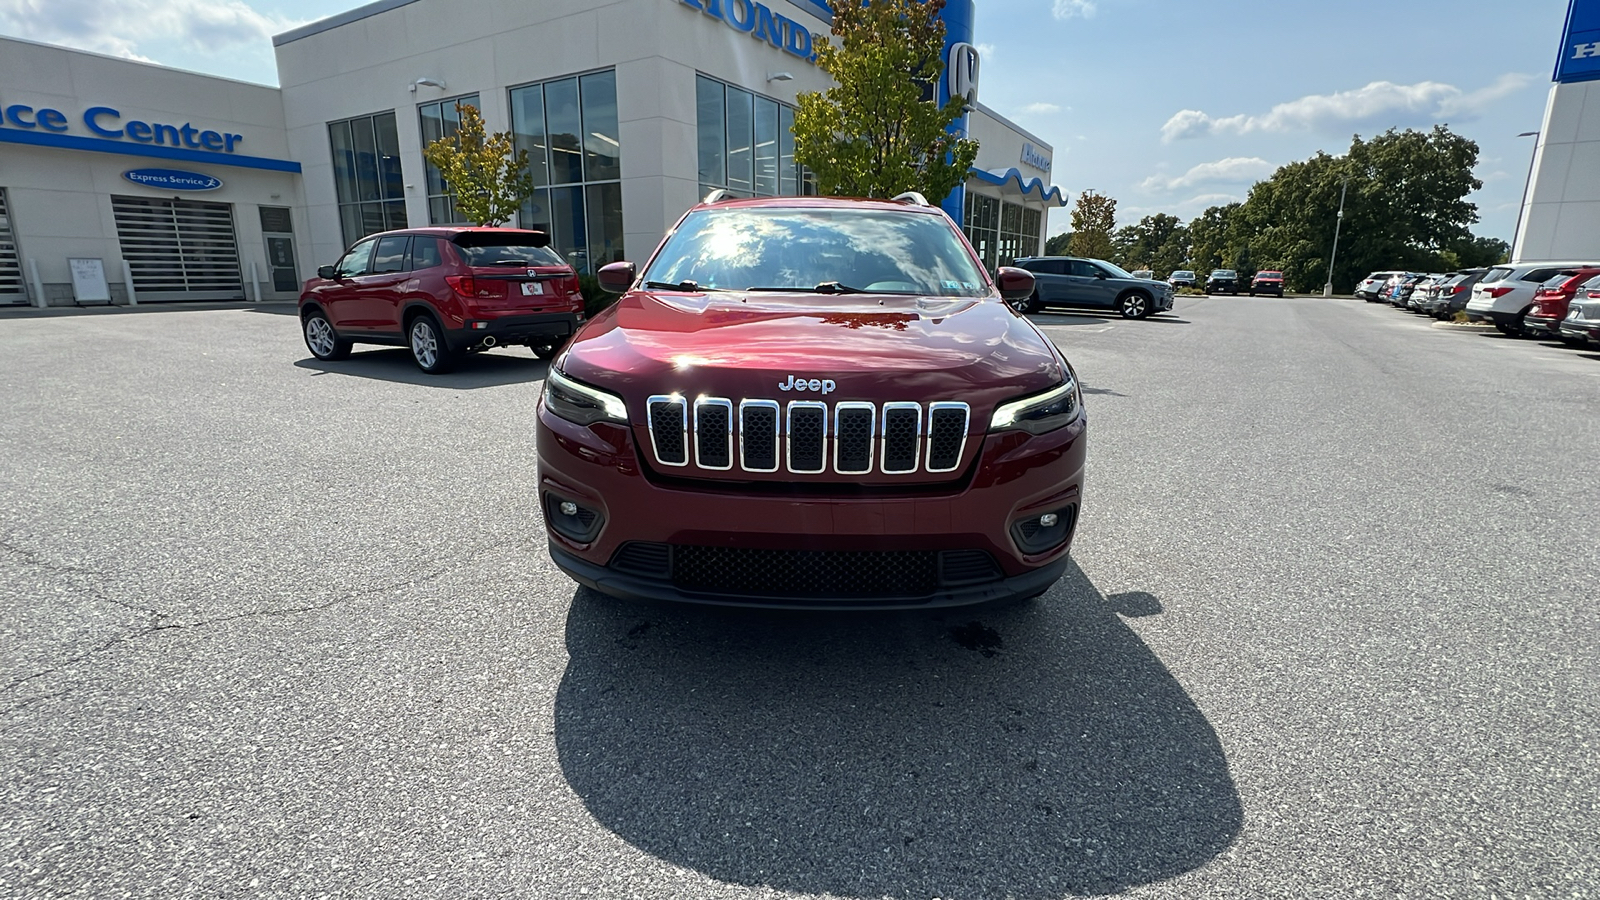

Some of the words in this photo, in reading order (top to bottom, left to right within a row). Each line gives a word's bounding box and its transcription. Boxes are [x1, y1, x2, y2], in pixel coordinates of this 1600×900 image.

[83, 106, 243, 152] Center
[129, 172, 168, 183] Express
[169, 175, 204, 185] Service
[778, 375, 836, 395] Jeep
